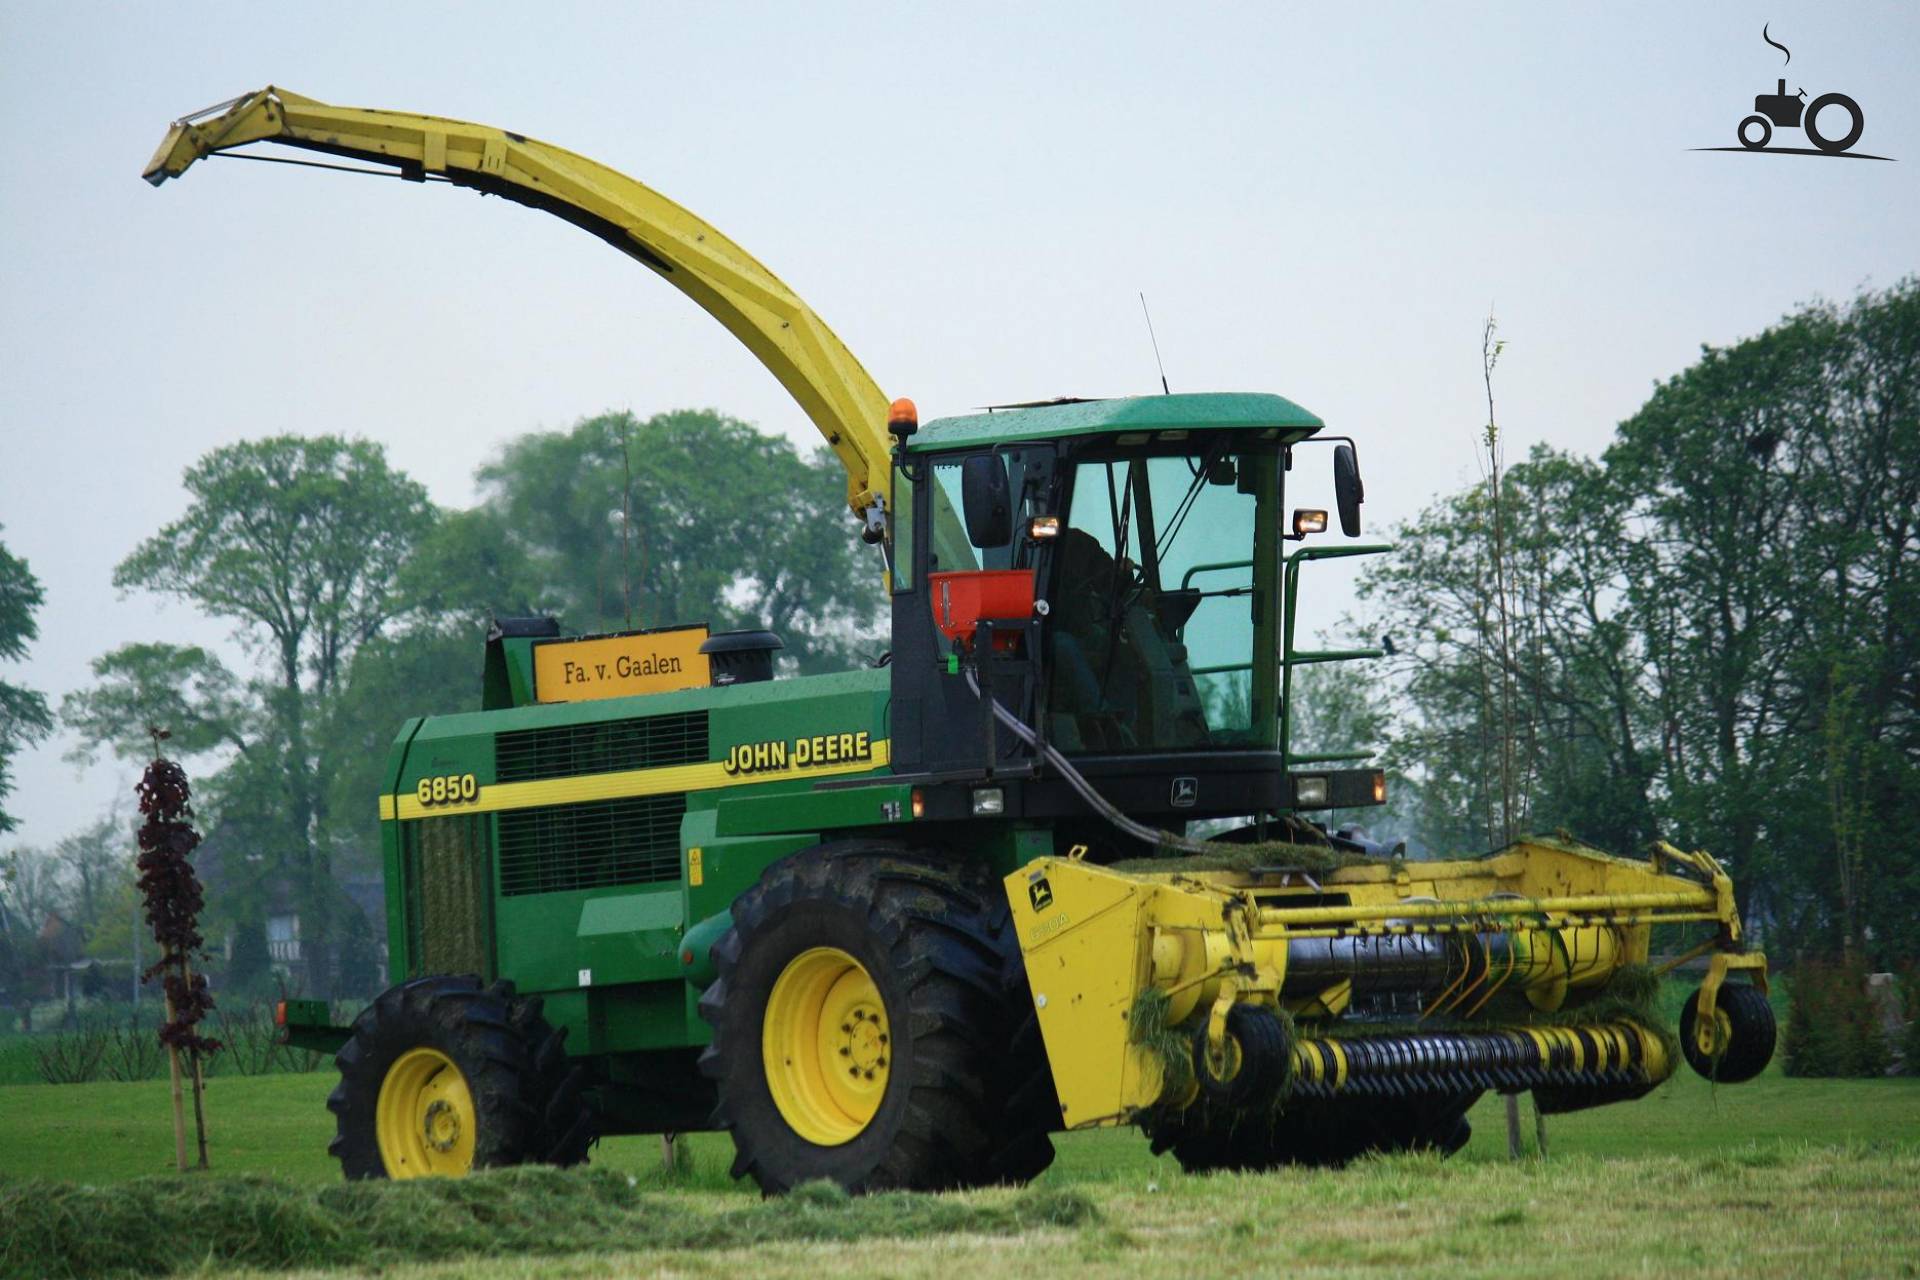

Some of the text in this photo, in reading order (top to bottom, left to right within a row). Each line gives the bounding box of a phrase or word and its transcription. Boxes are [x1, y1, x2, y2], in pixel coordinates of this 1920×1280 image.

[564, 653, 682, 684] Fa. v. Gaalen
[723, 731, 871, 775] JOHN DEERE
[417, 773, 479, 807] 6850
